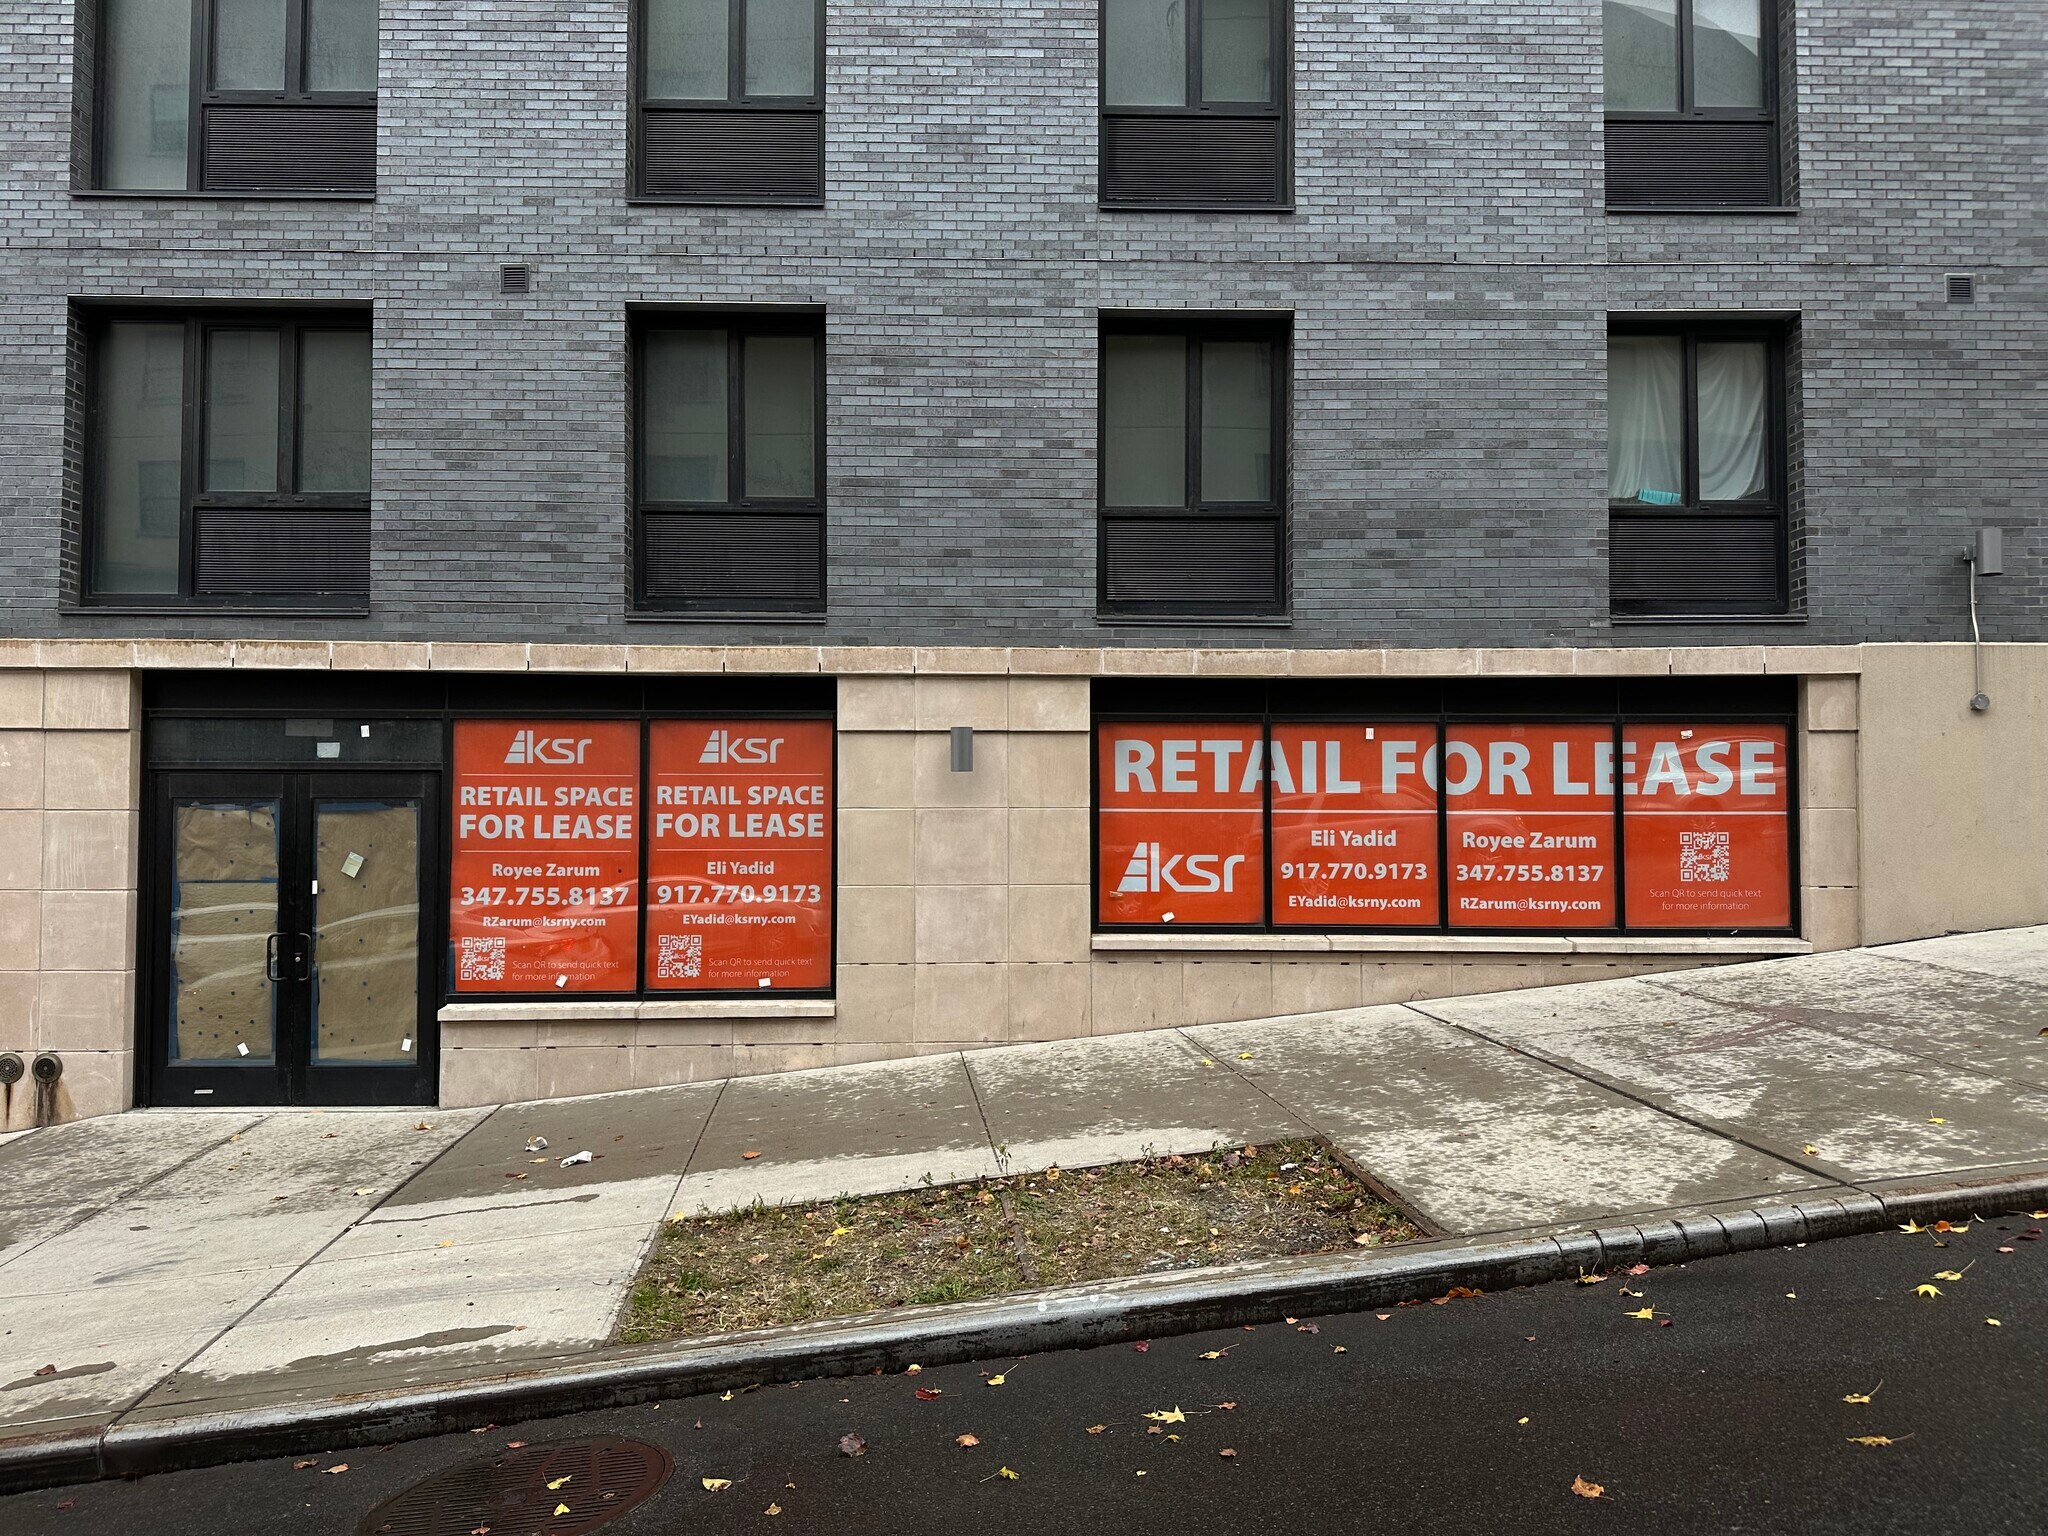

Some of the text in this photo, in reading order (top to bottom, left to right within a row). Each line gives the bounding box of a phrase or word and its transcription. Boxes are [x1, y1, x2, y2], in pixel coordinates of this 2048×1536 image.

[527, 730, 592, 764] ksr
[721, 730, 784, 763] ksr
[1114, 739, 1776, 796] RETAIL FOR LEASE
[460, 786, 633, 807] RETAIL SPACE
[656, 785, 824, 805] RETAIL SPACE
[460, 814, 632, 839] FOR LEASE
[656, 813, 824, 838] FOR LEASE
[1311, 830, 1397, 847] Eli Yadid
[1462, 832, 1597, 852] Royee Zarum
[492, 863, 600, 880] Royee Zarum
[707, 861, 775, 875] Eli Yadid
[1150, 842, 1245, 893] ksr
[1281, 863, 1427, 880] 917.770.9173
[1456, 865, 1604, 882] 347.755.8137
[460, 886, 629, 906] 347.755.8137
[657, 885, 821, 903] 917.770.9173
[1288, 895, 1421, 910] EYadid@ksrny.com
[1650, 889, 1670, 897] Scan
[1672, 889, 1685, 898] QR
[1697, 889, 1718, 897] send
[1720, 889, 1743, 900] quick
[1745, 889, 1761, 897] text
[1460, 897, 1601, 912] RZarum@ksrny.com
[1662, 901, 1674, 910] for
[1700, 901, 1749, 910] information
[482, 916, 606, 929] RZarum@ksrny.com
[682, 913, 796, 926] EYadid@ksrny.com
[512, 961, 532, 969] Scan
[534, 961, 546, 970] QR
[557, 961, 577, 969] send
[580, 961, 601, 971] quick
[708, 958, 727, 966] Scan
[730, 958, 742, 967] QR
[753, 958, 772, 966] send
[775, 958, 795, 968] quick
[708, 970, 719, 978] for
[744, 970, 789, 978] information
